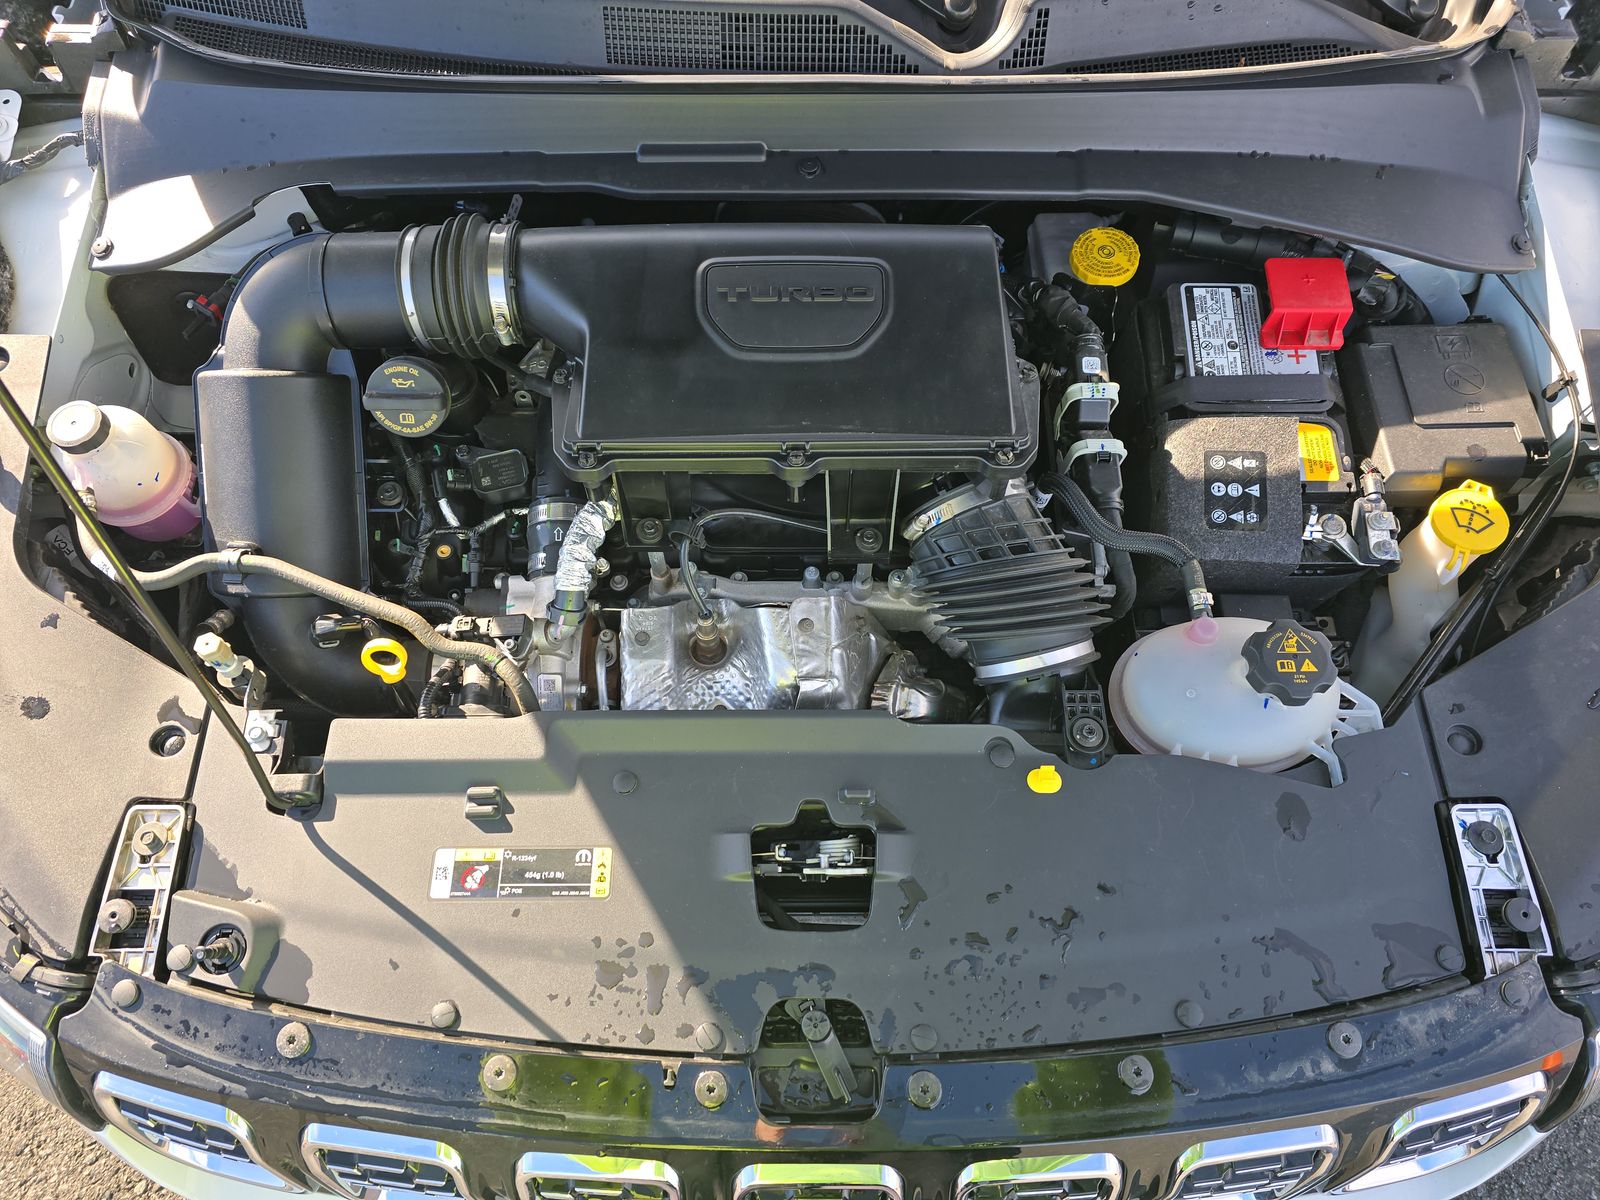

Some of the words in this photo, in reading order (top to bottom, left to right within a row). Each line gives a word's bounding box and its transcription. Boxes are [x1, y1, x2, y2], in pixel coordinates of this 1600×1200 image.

[716, 286, 876, 303] TURBO
[1190, 320, 1201, 361] DANGER/POISON
[384, 366, 408, 375] ENGINE
[409, 368, 419, 377] OIL
[375, 411, 384, 420] API
[524, 871, 541, 879] 454g
[542, 871, 555, 879] (1.0
[555, 871, 565, 879] lb)
